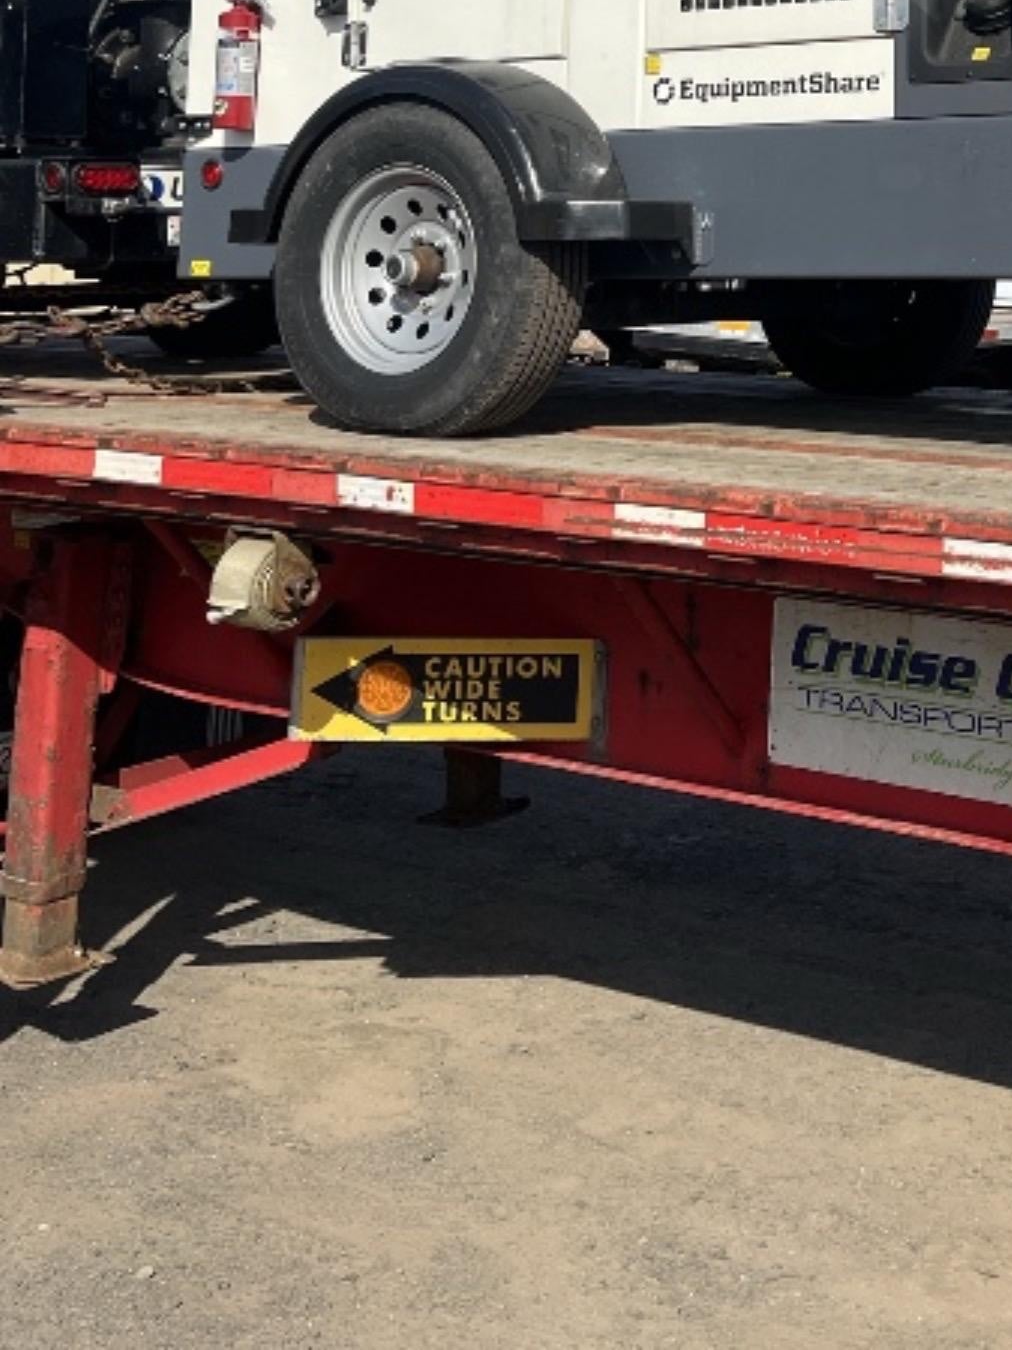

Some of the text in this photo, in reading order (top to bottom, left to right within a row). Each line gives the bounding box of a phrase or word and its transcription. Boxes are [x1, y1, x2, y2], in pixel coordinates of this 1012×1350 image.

[679, 71, 881, 103] EquipmentShare
[424, 656, 563, 679] CAUTION
[790, 623, 978, 697] Cruise
[422, 680, 502, 700] WIDE
[421, 701, 521, 722] TURNS
